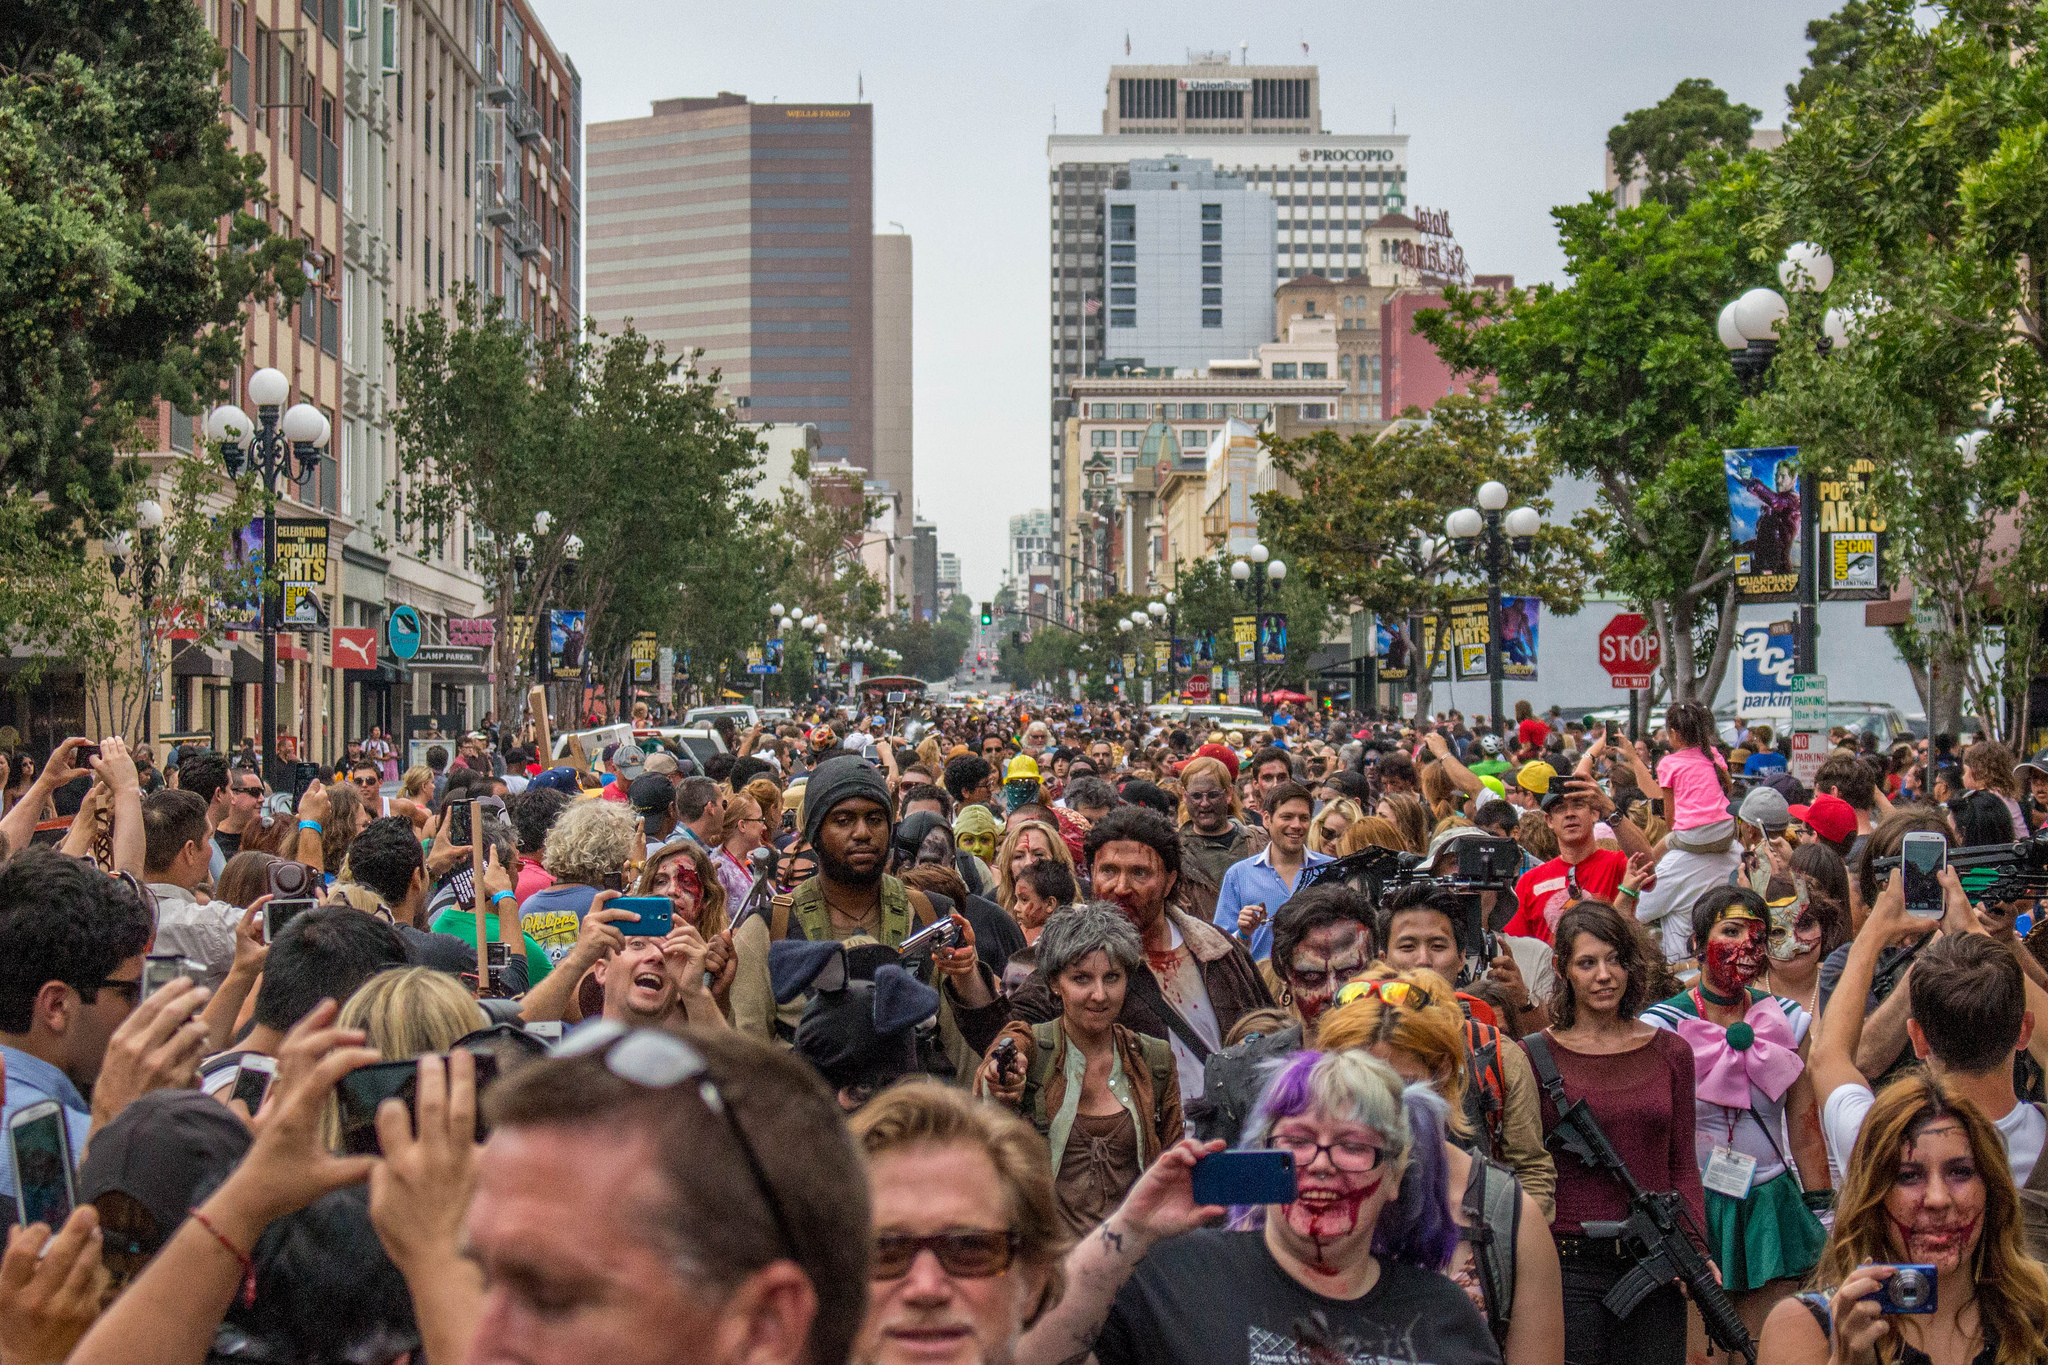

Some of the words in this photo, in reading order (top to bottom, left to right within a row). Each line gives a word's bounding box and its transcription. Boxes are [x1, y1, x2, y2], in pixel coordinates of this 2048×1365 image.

[1191, 80, 1250, 89] UnionBank
[786, 110, 818, 118] WELLS
[820, 110, 851, 118] FARGO
[1313, 149, 1394, 162] PROCOPIO
[277, 526, 327, 538] CELEBRATING
[277, 543, 327, 558] POPULAR
[1848, 540, 1875, 553] CON
[1834, 540, 1848, 580] COMIC
[277, 557, 326, 581] ARTS
[1738, 574, 1799, 587] GUARDIANS
[1752, 583, 1797, 594] GALAXY
[286, 586, 297, 617] COMIC
[449, 619, 494, 632] PINK
[1452, 615, 1489, 629] POPULAR
[450, 632, 494, 646] ZONE
[1453, 627, 1490, 646] ARTS
[1603, 635, 1658, 661] STOP
[1189, 681, 1210, 692] STOP
[1615, 678, 1628, 686] ALL
[1632, 678, 1648, 686] WAY
[1793, 678, 1804, 691] 30
[1806, 681, 1825, 689] MINUTE
[1742, 694, 1793, 712] parkin
[1795, 696, 1825, 706] PARKING
[1795, 735, 1807, 748] NO
[1796, 753, 1825, 762] PARKING
